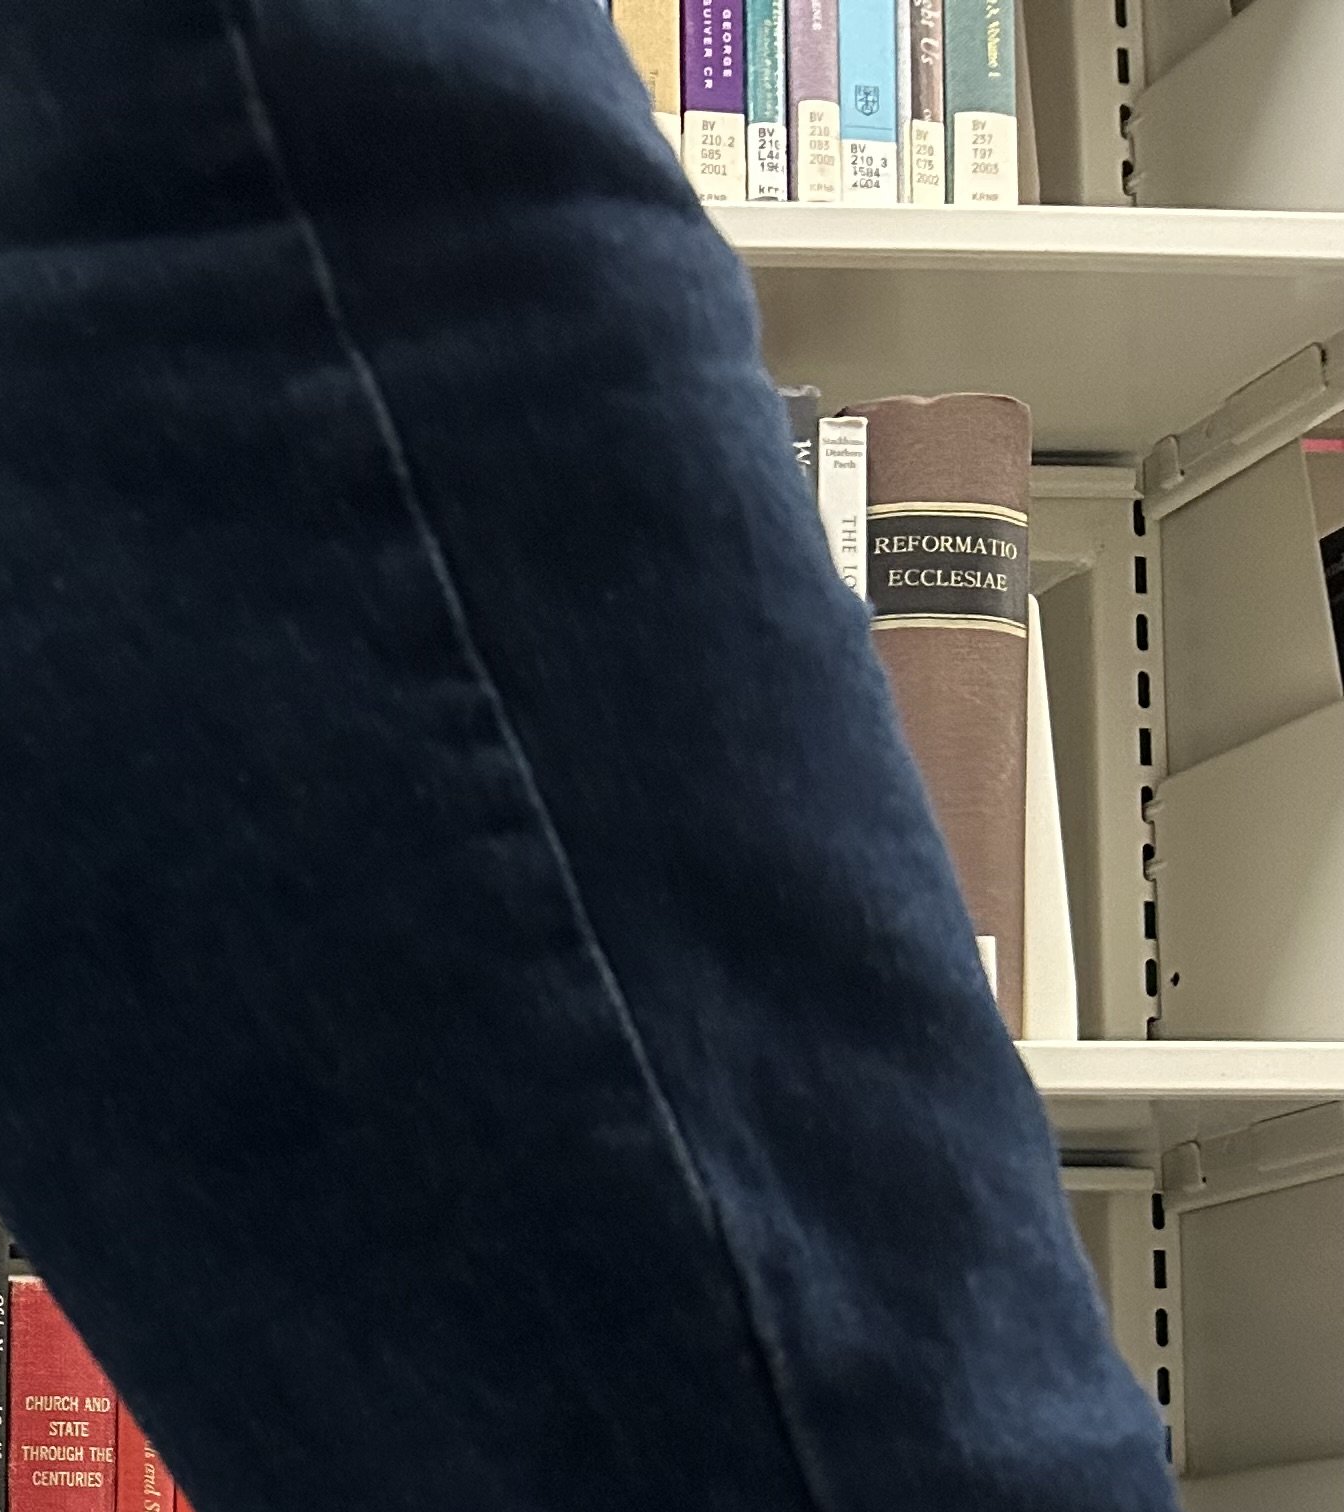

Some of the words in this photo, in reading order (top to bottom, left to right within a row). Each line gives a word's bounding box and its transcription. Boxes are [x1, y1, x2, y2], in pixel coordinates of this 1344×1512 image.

[722, 9, 732, 77] GEORGE
[702, 120, 715, 131] BV
[701, 163, 727, 176] 2001
[874, 536, 1017, 560] REFORMATIO
[888, 569, 1009, 593] ECCLESIAE
[26, 1396, 78, 1412] CHURCH
[85, 1398, 110, 1412] AND
[50, 1421, 89, 1437] STATE
[22, 1445, 83, 1461] THROUGH
[89, 1446, 114, 1462] THE
[32, 1471, 103, 1487] CENTURIES
